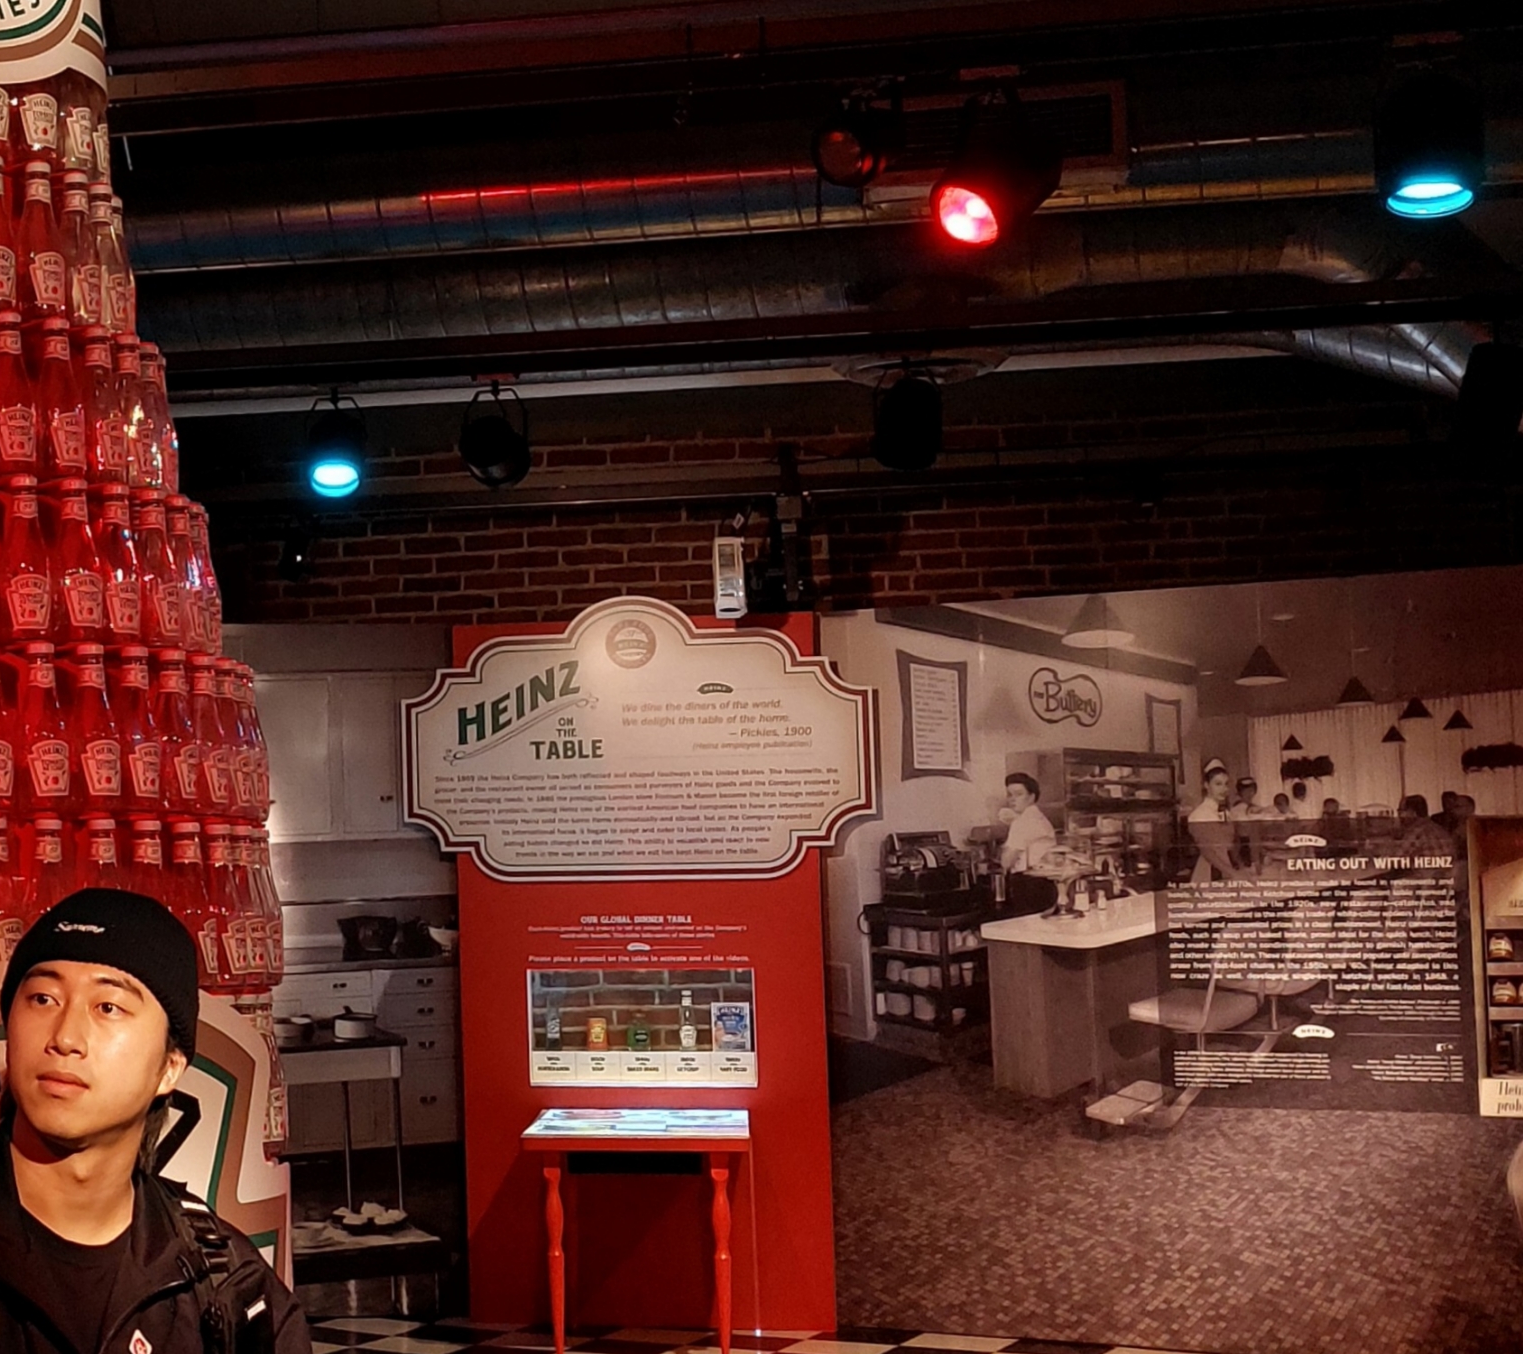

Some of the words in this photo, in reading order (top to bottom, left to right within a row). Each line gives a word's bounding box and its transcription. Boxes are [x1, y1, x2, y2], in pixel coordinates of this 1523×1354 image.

[457, 660, 581, 745] HEINZ
[558, 717, 574, 727] ON
[556, 728, 577, 738] THE
[783, 726, 813, 737] 1900
[530, 740, 604, 760] TABLE
[1287, 857, 1336, 871] EATING
[1339, 857, 1369, 870] OUT
[1373, 856, 1410, 869] WITH
[1413, 855, 1454, 868] HEINZ
